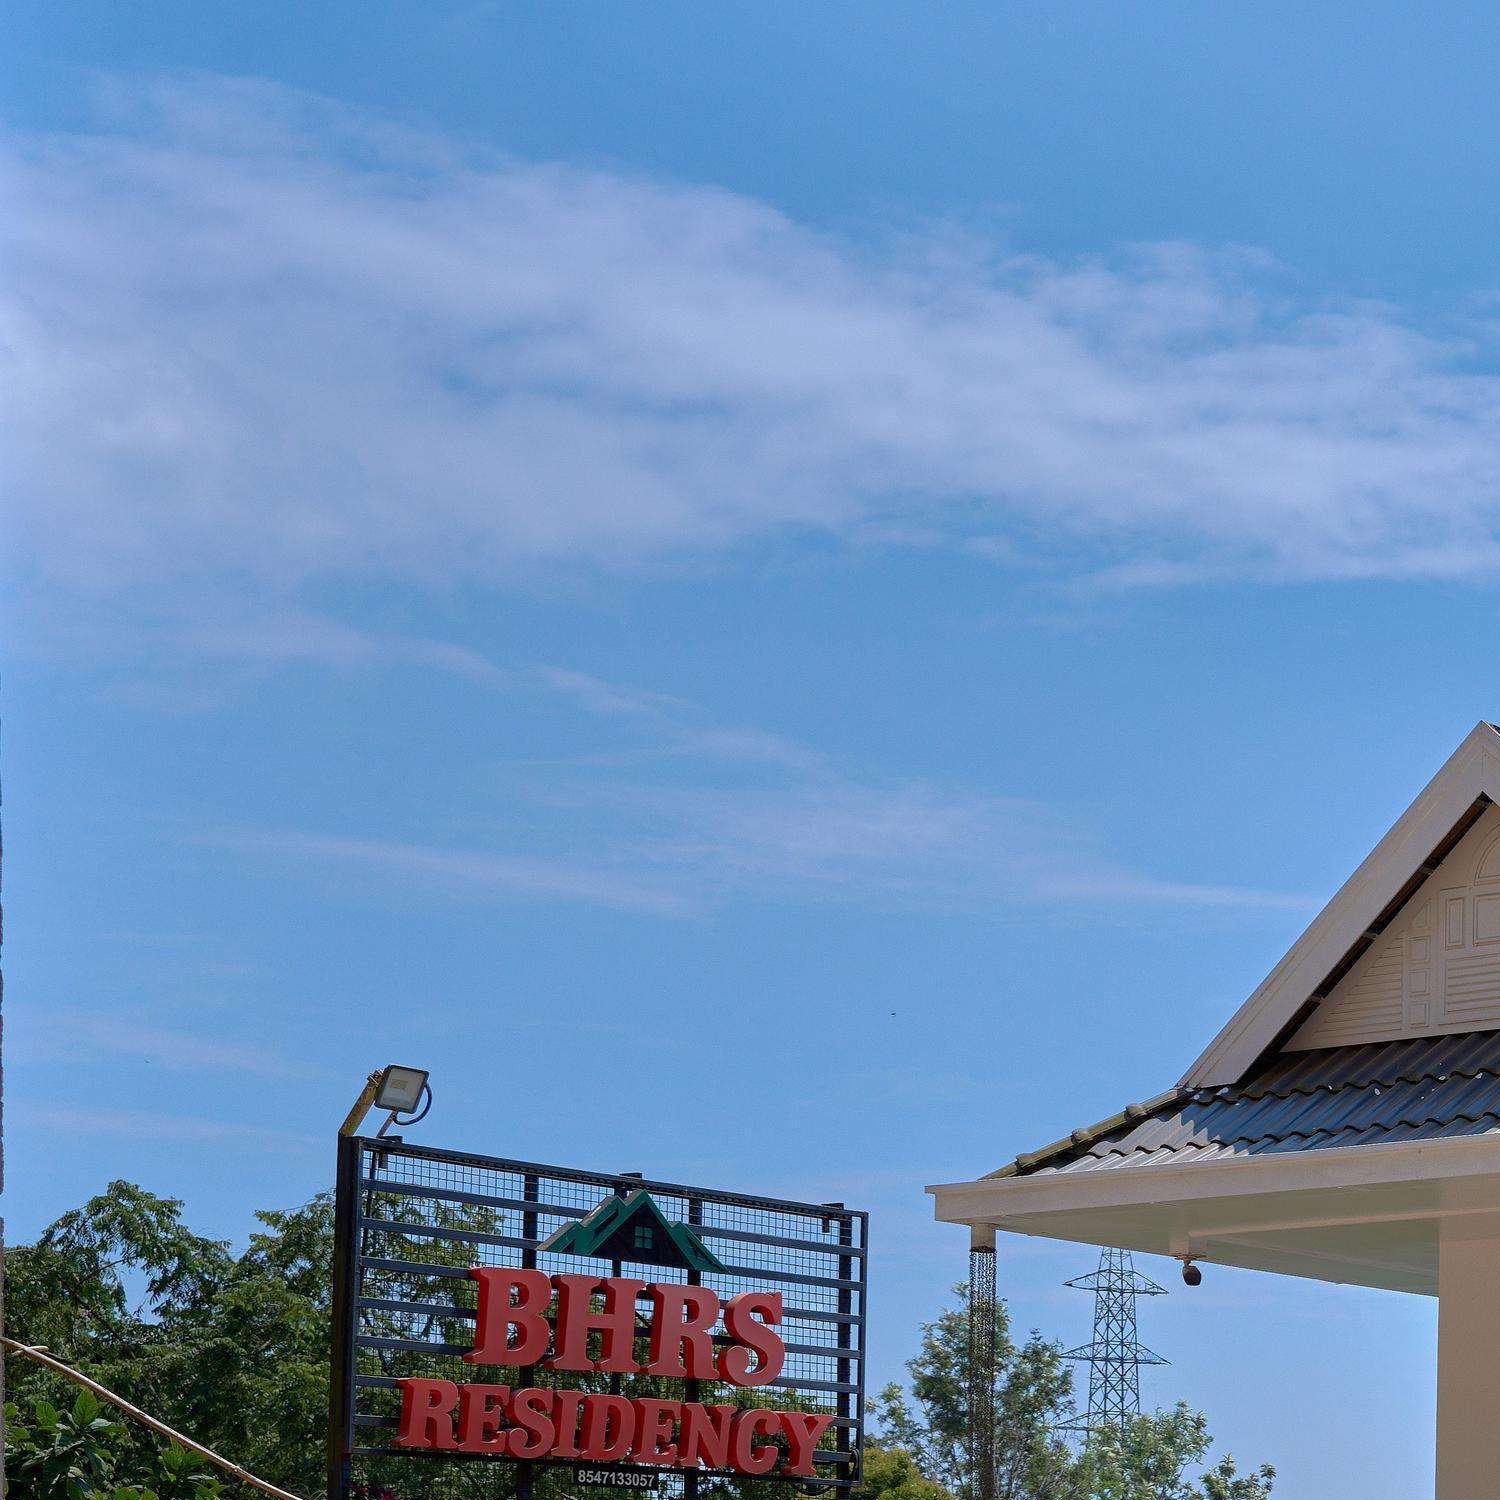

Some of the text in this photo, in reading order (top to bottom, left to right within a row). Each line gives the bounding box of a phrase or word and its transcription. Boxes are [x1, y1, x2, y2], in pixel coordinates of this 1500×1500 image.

[464, 1267, 786, 1386] BHRS
[393, 1377, 835, 1475] RESIDENCY
[577, 1469, 655, 1487] 8547133057
